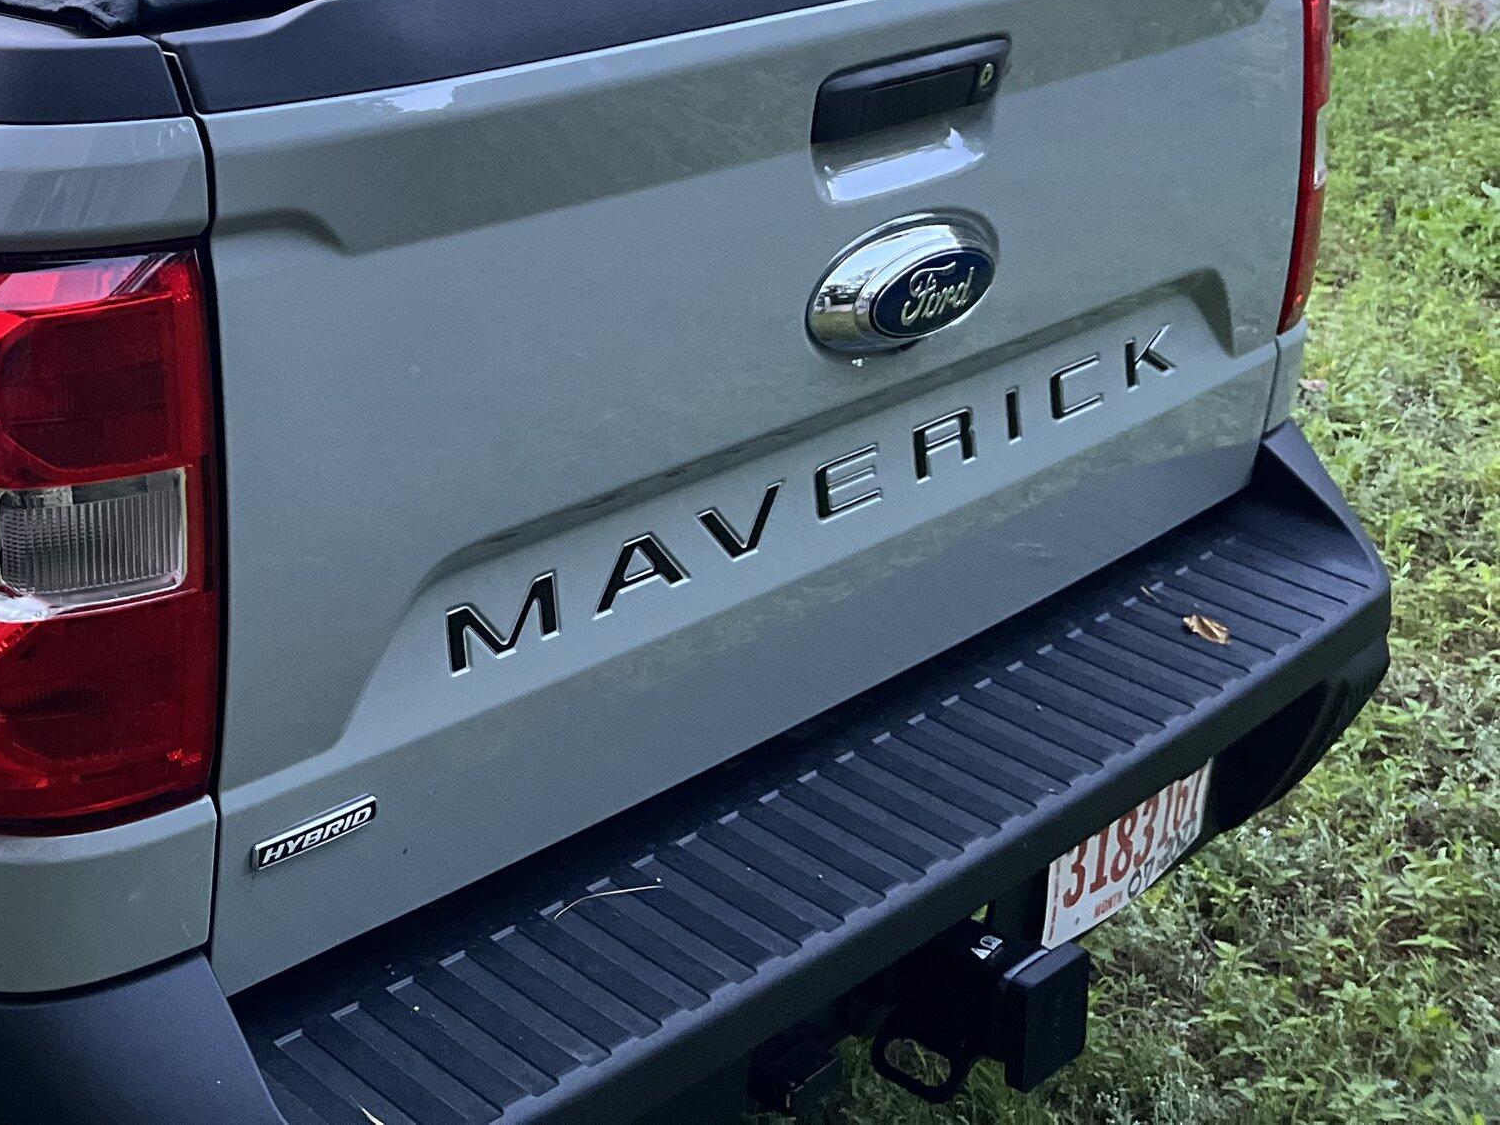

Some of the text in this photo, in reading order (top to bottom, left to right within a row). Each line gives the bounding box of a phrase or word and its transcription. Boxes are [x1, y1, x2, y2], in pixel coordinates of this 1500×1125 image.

[901, 260, 975, 327] Ford
[444, 322, 1179, 677] MAVERICK
[261, 806, 372, 865] HYBRID
